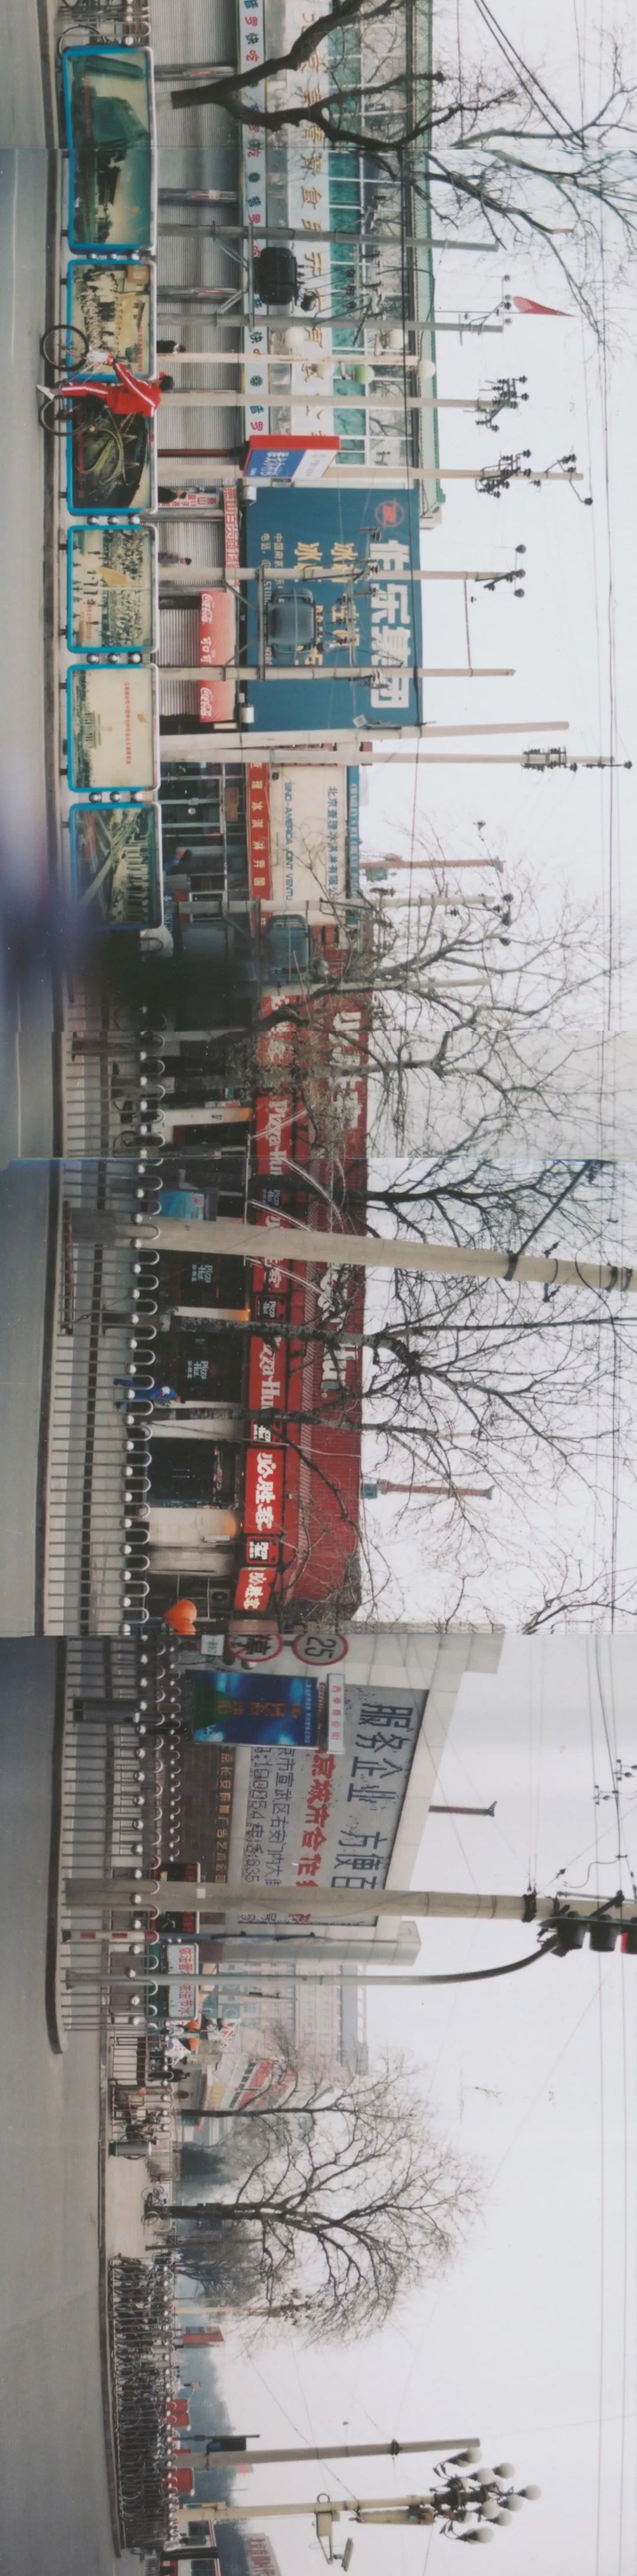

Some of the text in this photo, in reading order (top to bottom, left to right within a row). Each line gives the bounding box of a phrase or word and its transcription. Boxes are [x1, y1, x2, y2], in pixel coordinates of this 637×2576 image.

[327, 787, 338, 902] 北京查理冰淇淋有限公
[203, 1265, 213, 1284] Pizza
[199, 1360, 209, 1380] Pizza
[255, 1452, 277, 1531] 必胜客
[242, 1572, 268, 1610] 必胜客
[304, 1636, 337, 1659] 25
[331, 1685, 342, 1740] 西单商业街
[331, 1703, 413, 1889] 服务企业 方便百
[179, 1947, 193, 1975] 依法管
